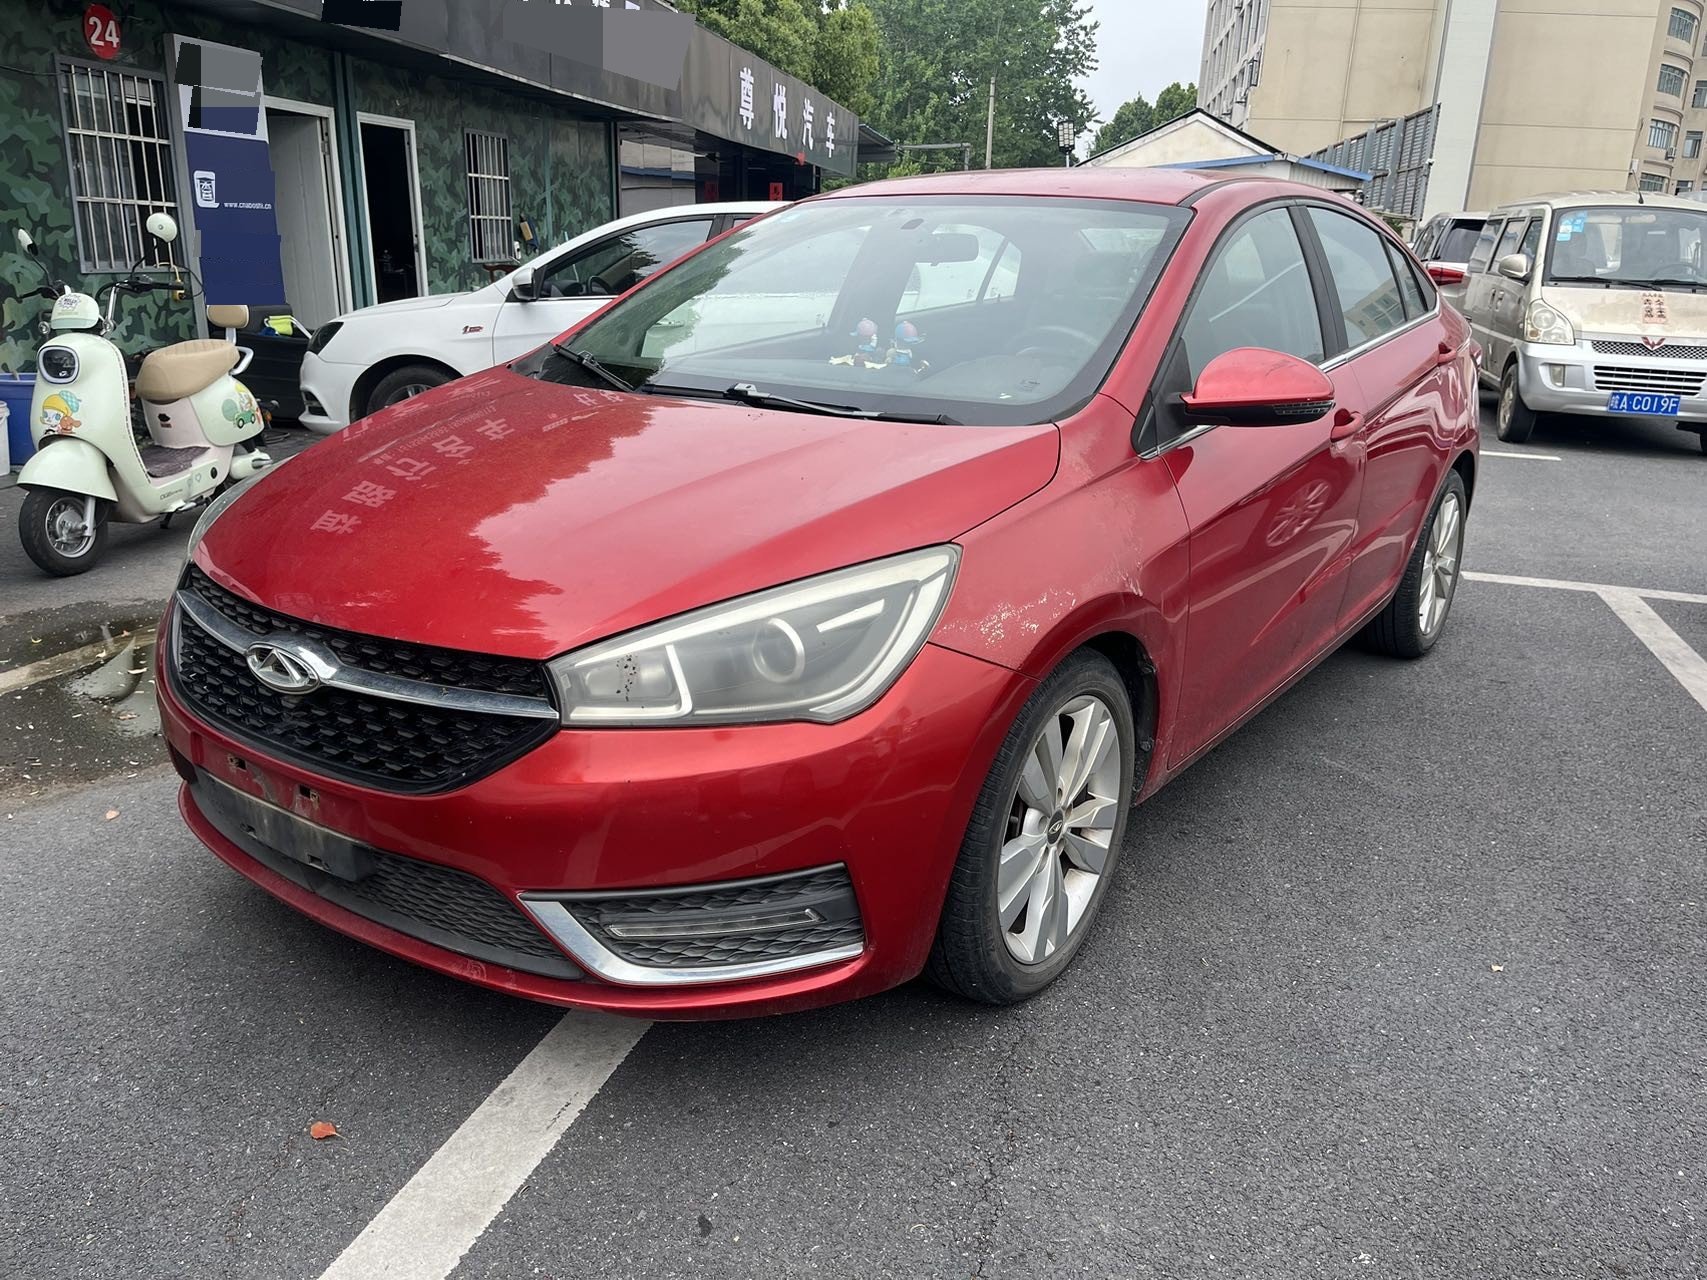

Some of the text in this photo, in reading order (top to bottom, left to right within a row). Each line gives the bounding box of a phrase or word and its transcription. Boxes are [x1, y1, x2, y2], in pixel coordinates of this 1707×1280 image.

[89, 16, 119, 47] 24
[740, 67, 835, 158] 尊悦汽车
